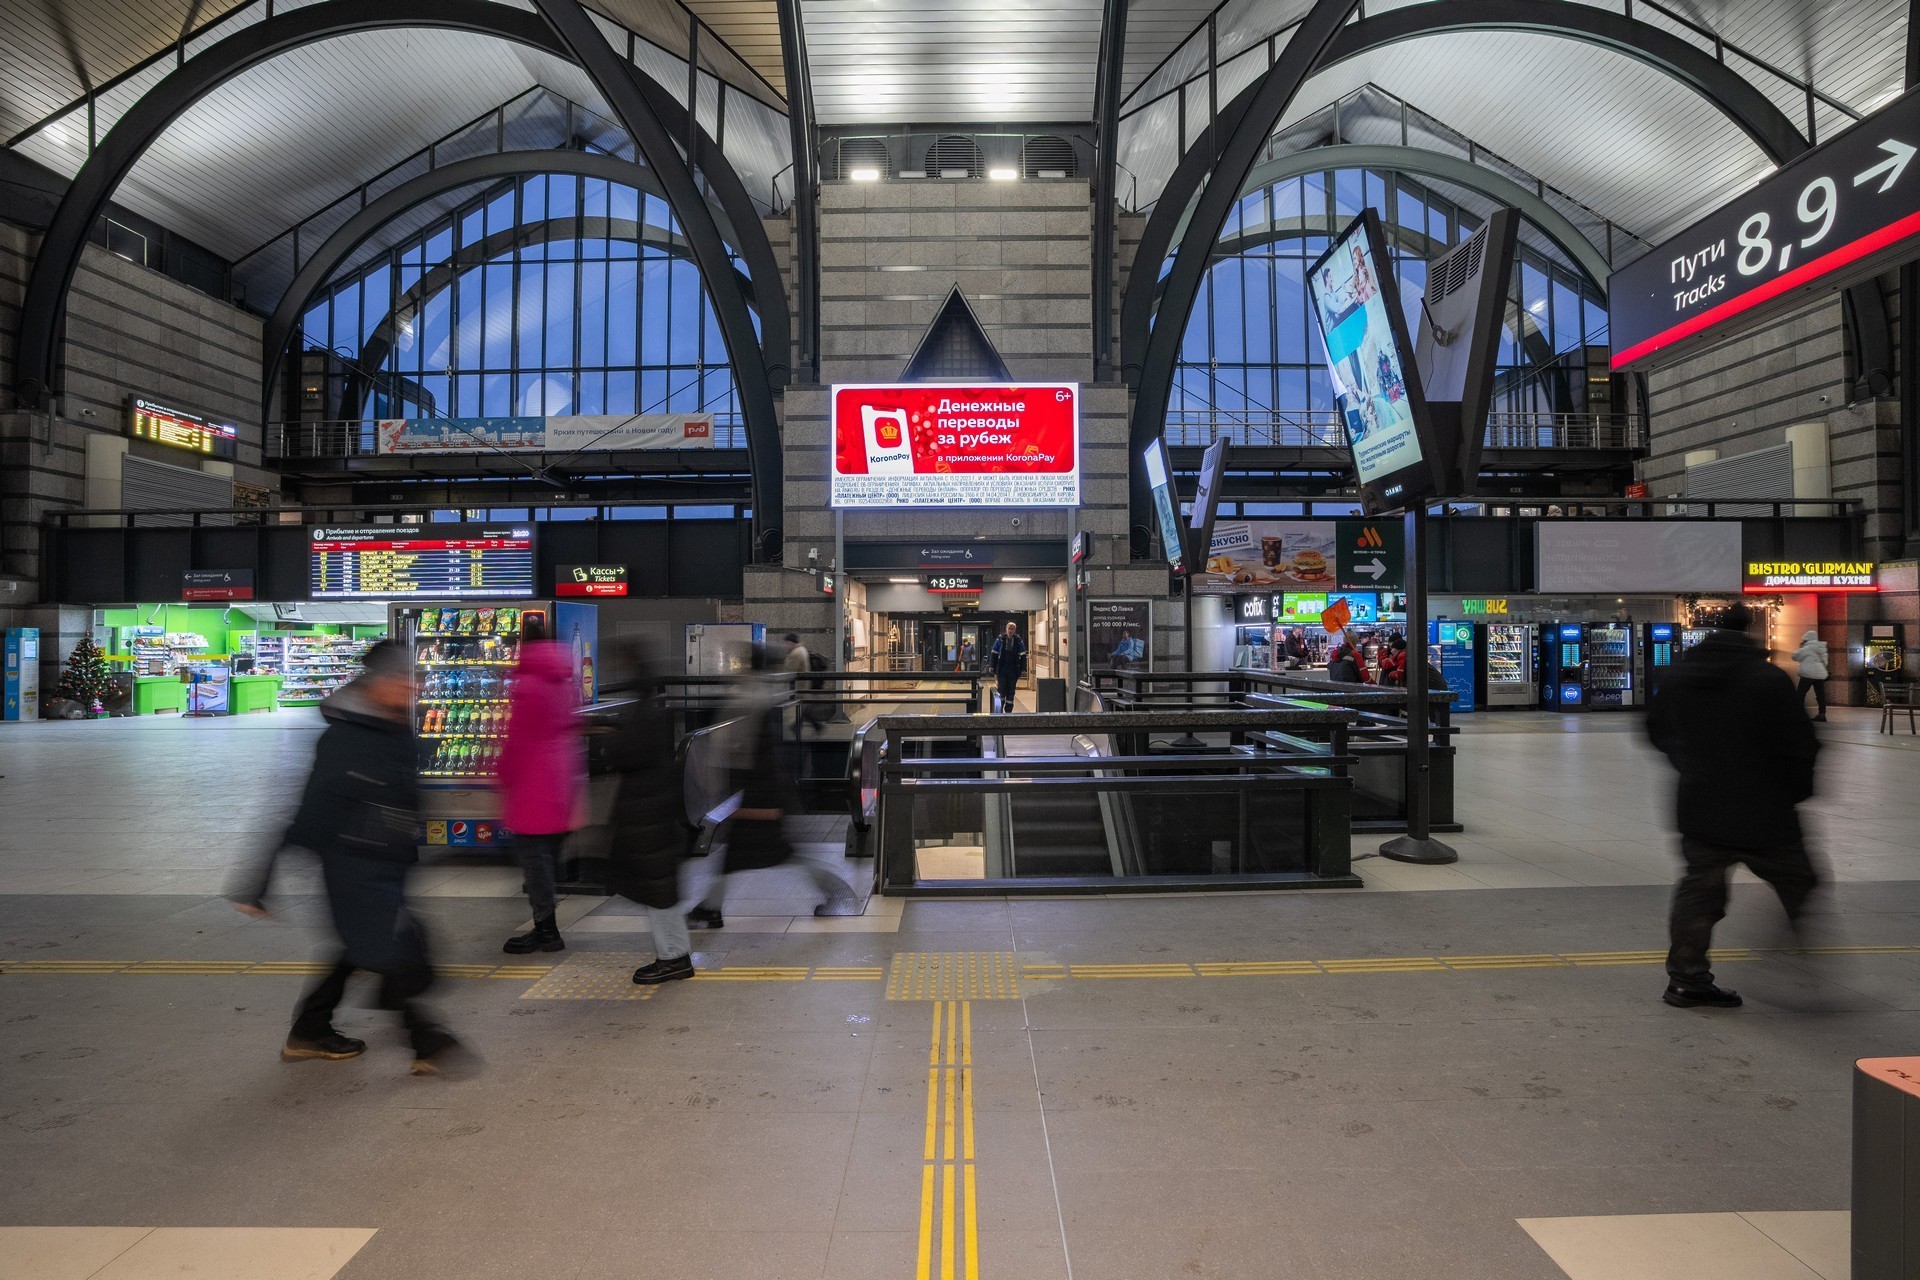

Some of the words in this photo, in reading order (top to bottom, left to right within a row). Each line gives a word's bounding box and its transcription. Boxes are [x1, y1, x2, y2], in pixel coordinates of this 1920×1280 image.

[1671, 238, 1725, 284] Пути
[1737, 176, 1837, 276] 8,9
[1673, 273, 1726, 312] Tracks
[1055, 391, 1071, 402] 6+
[938, 399, 1026, 414] Денежные
[938, 418, 1020, 431] переводы
[577, 428, 624, 436] путешествий
[938, 434, 955, 444] за
[960, 432, 1012, 447] рубеж
[1358, 441, 1387, 458] Туристические
[1387, 430, 1411, 444] маршруты
[1366, 450, 1386, 462] железным
[1387, 441, 1405, 453] дорогам
[870, 453, 910, 464] KoronaPay
[945, 454, 1004, 463] приложении
[1006, 454, 1055, 464] KoronaPay
[1362, 463, 1375, 472] России
[1385, 485, 1402, 496] ОЛИМП
[1210, 534, 1249, 547] ВКУСНО
[590, 567, 616, 575] Кассы
[1749, 563, 1800, 575] BISTRO
[939, 578, 956, 589] 8,9
[1765, 576, 1830, 586] ДОМАШНЯЯ
[1834, 576, 1870, 585] КУХНЯ
[1244, 597, 1263, 616] cofix
